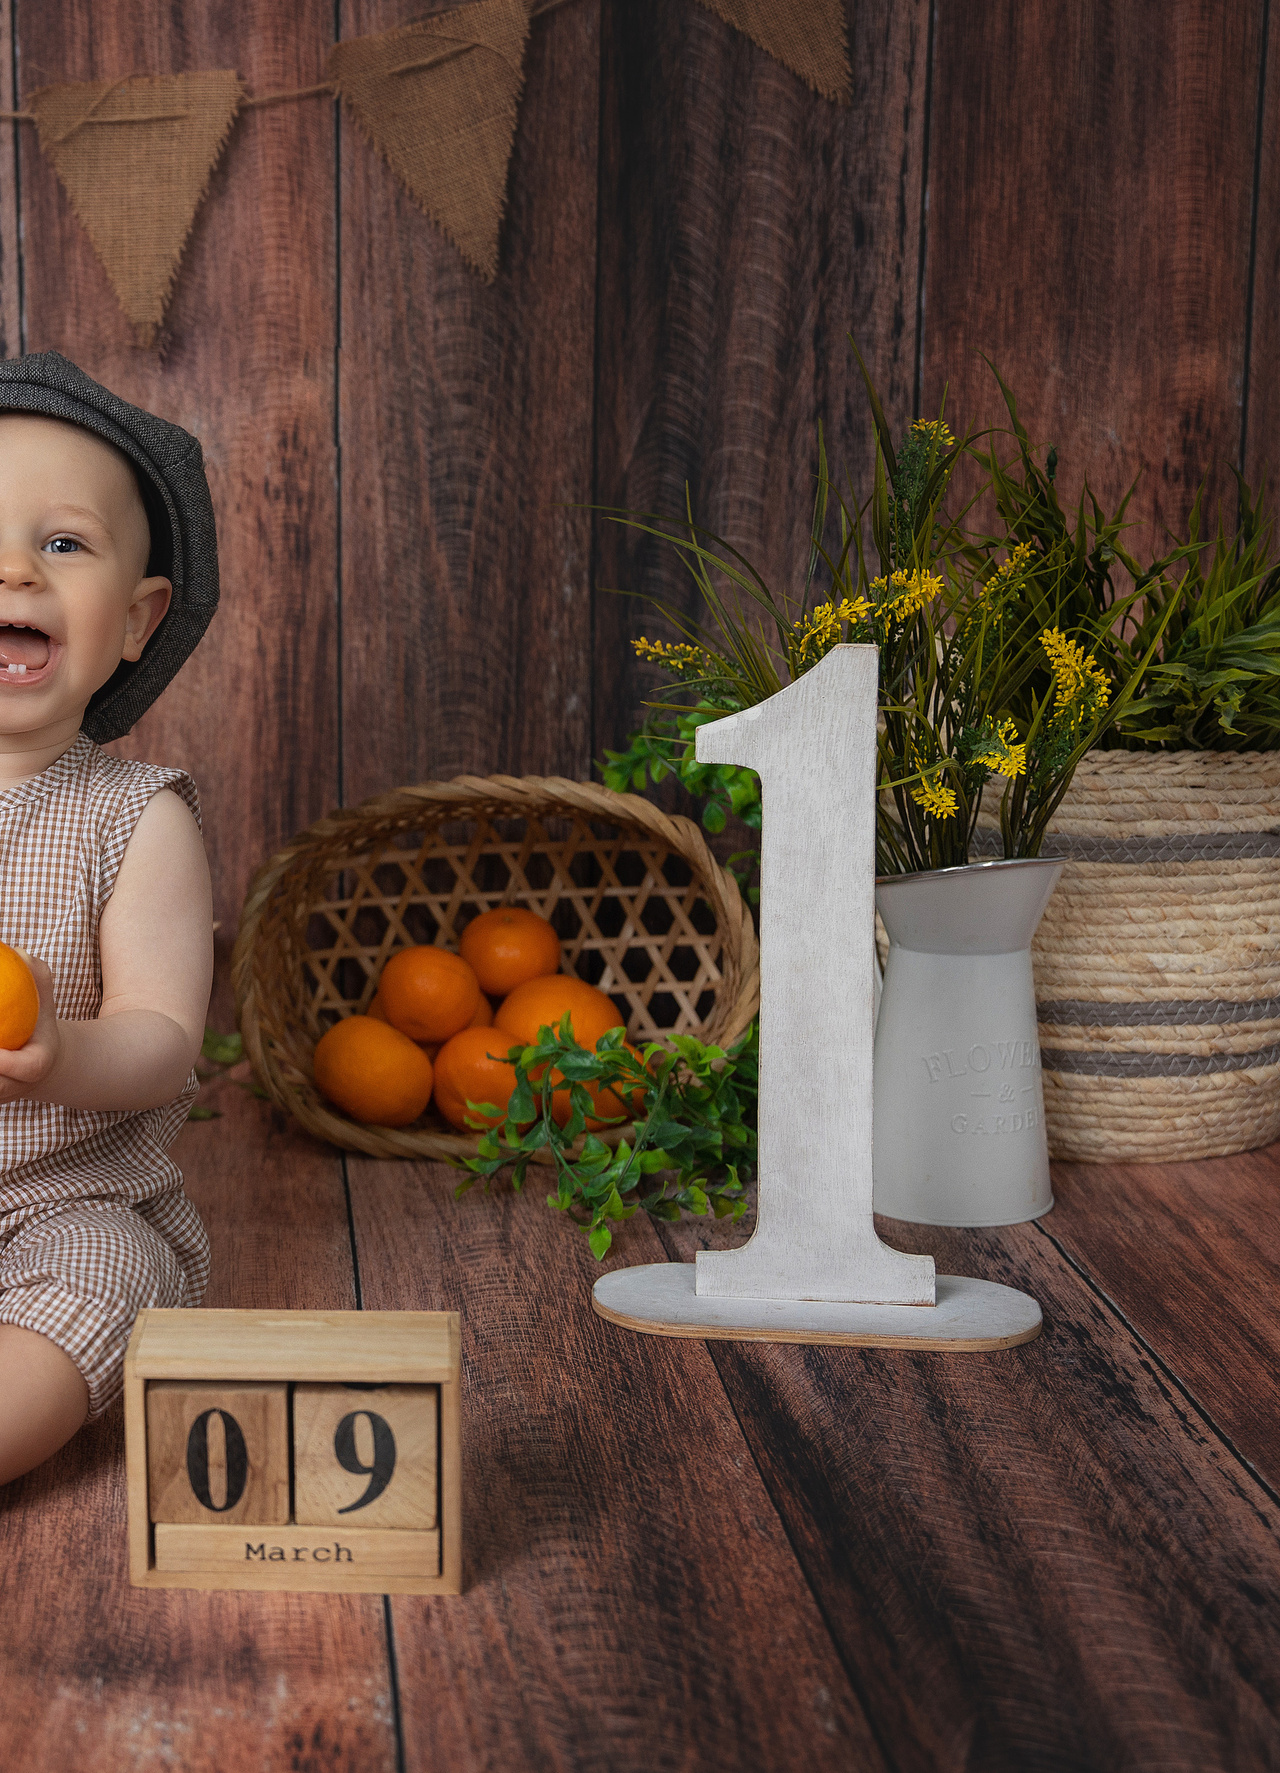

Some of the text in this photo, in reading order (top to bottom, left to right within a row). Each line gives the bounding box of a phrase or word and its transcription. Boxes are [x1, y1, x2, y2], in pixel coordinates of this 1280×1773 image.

[695, 643, 936, 1307] 1
[951, 1107, 1040, 1134] GARDE
[245, 1542, 355, 1563] March
